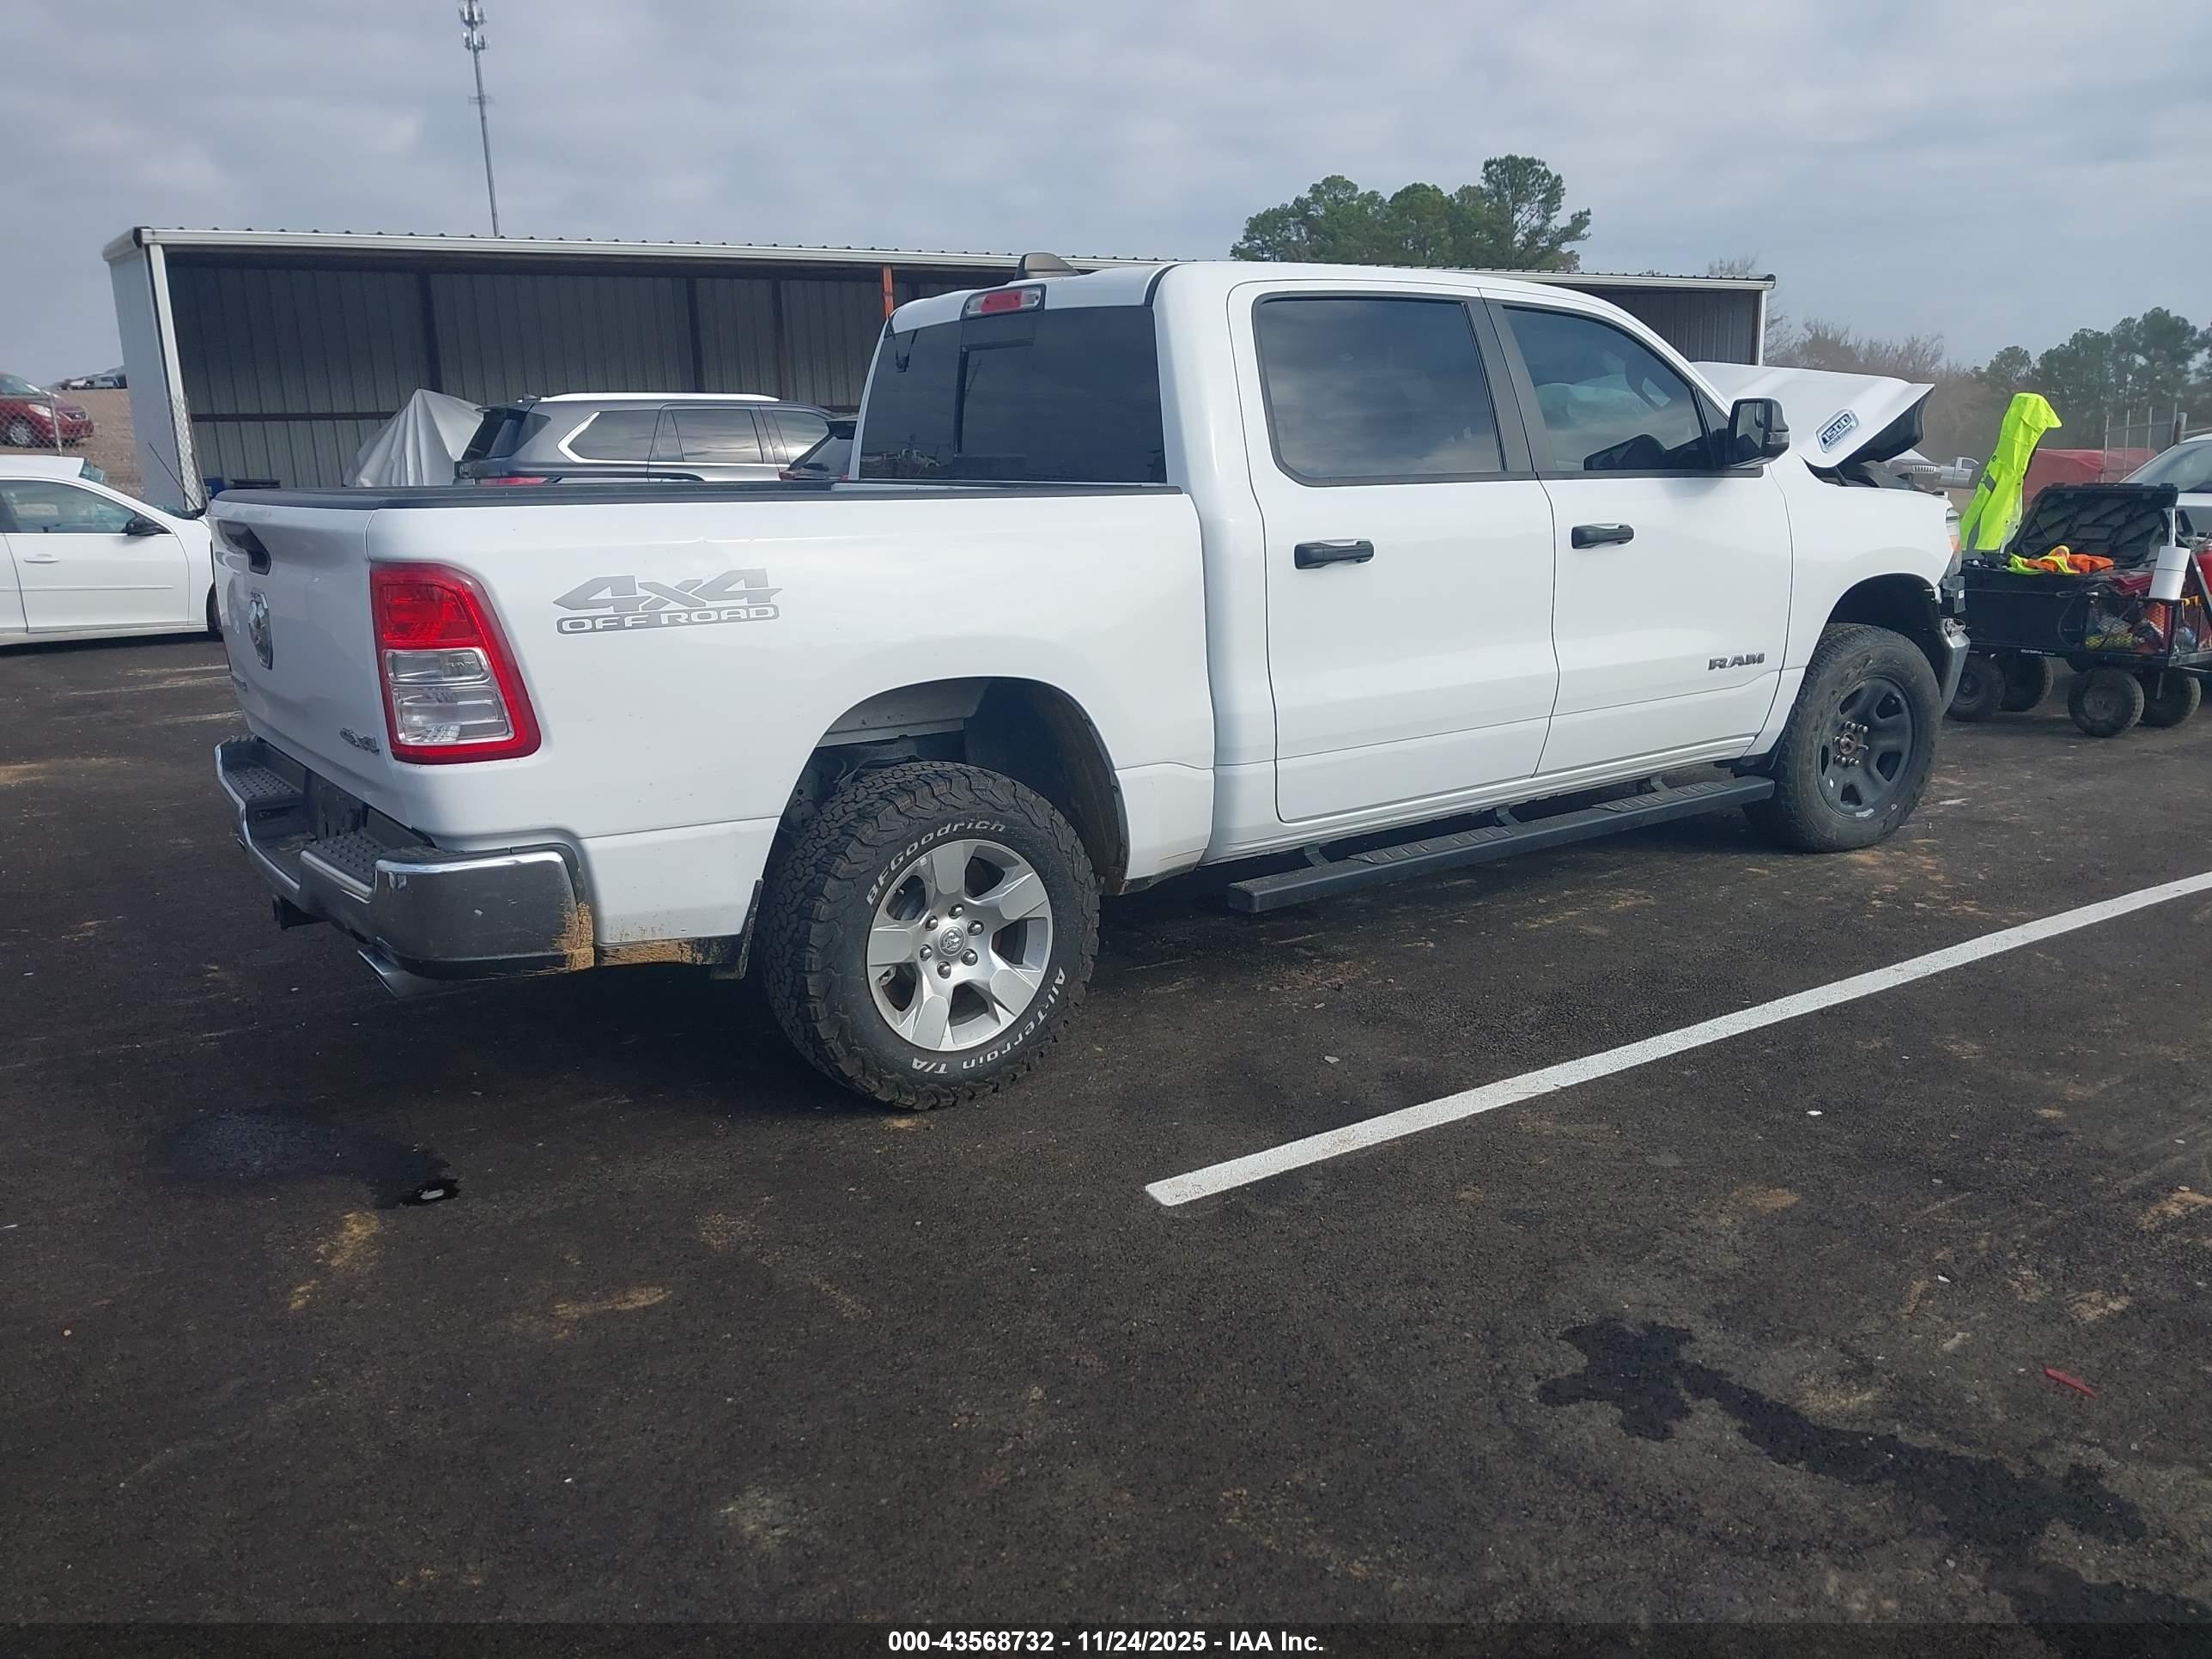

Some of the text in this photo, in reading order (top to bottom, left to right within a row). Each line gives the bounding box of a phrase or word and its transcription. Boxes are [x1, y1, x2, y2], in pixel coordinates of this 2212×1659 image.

[1822, 415, 1850, 441] 1500
[562, 606, 776, 632] OFF ROAD
[1708, 652, 1765, 671] RAM
[864, 818, 1007, 906] BFGoodrich
[911, 966, 1067, 1074] All-Terrain T/A
